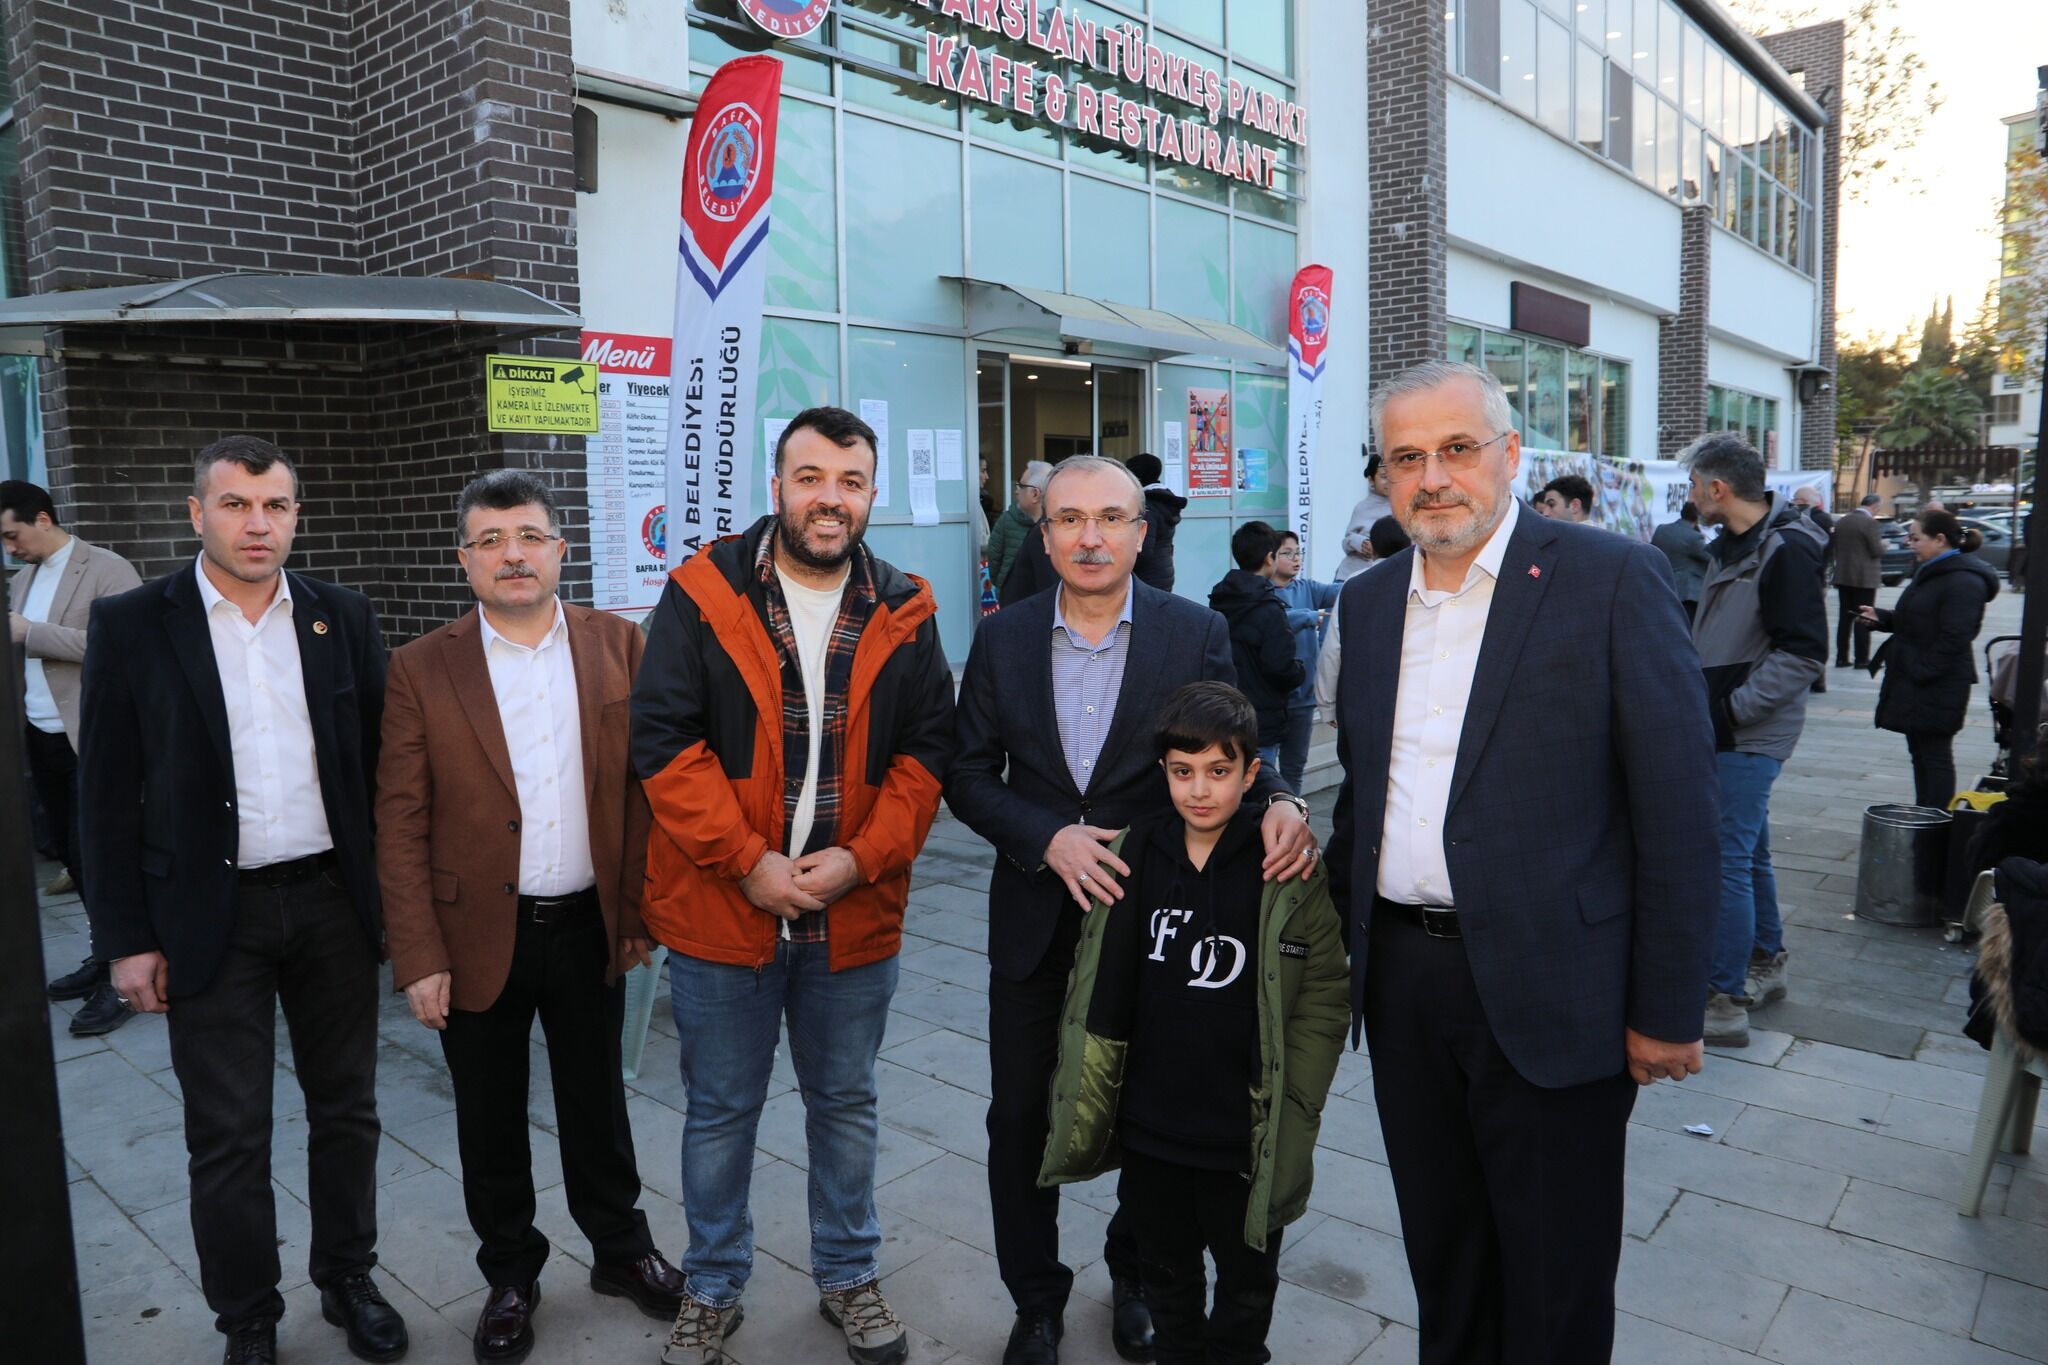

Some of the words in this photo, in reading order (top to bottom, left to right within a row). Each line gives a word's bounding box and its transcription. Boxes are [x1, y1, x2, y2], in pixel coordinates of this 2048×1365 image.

[744, 0, 824, 34] LEDİYES
[917, 0, 1096, 67] RSLAN
[1103, 22, 1221, 125] TÜRKEŞ
[1228, 77, 1306, 146] PARKI
[926, 31, 1033, 115] KAFE
[1045, 74, 1067, 122] &
[1077, 83, 1277, 189] RESTAURANT
[582, 338, 656, 369] Menü
[509, 367, 554, 382] DİKKAT
[508, 383, 546, 398] İŞYERİMİZ
[600, 382, 611, 393] er
[627, 381, 670, 397] Yiyecek
[497, 399, 530, 411] KAMERA
[531, 399, 543, 412] İLE
[545, 400, 590, 414] İZLENMEKTE
[715, 326, 741, 500] MÜDÜRLÜĞÜ
[497, 415, 507, 424] VE
[509, 415, 531, 425] KAYIT
[533, 416, 592, 427] YAPILMAKTADIR
[635, 565, 658, 573] BAFRA
